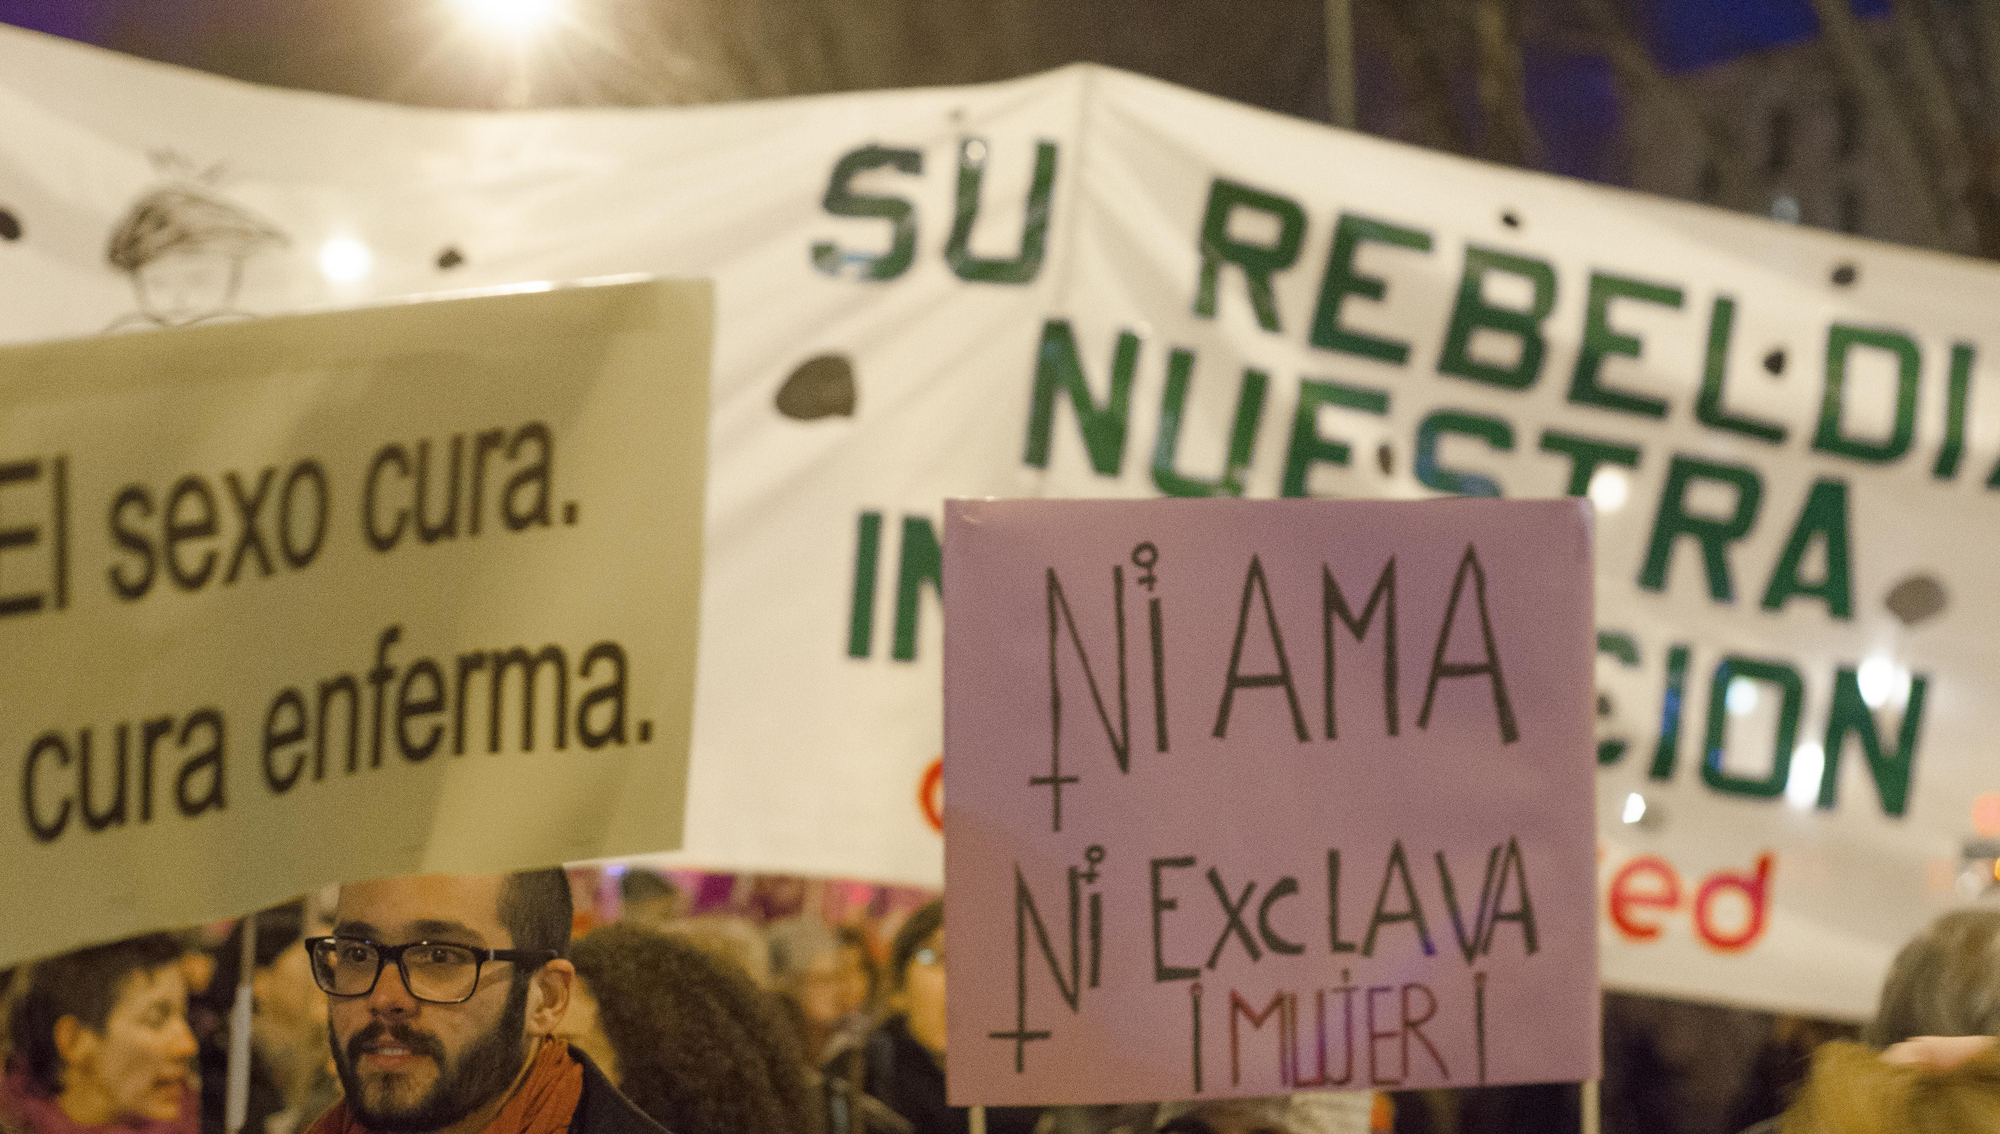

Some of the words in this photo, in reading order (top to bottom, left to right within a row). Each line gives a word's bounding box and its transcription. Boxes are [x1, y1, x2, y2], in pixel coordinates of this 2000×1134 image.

[811, 138, 1059, 284] SU
[1193, 176, 2000, 480] REBELDI
[0, 453, 71, 614] El
[107, 456, 330, 603] sexo
[361, 420, 580, 553] cura.
[22, 706, 227, 846] cura
[261, 625, 656, 795] enferma.
[1211, 541, 1520, 746] AMA
[1597, 849, 1776, 957] ed
